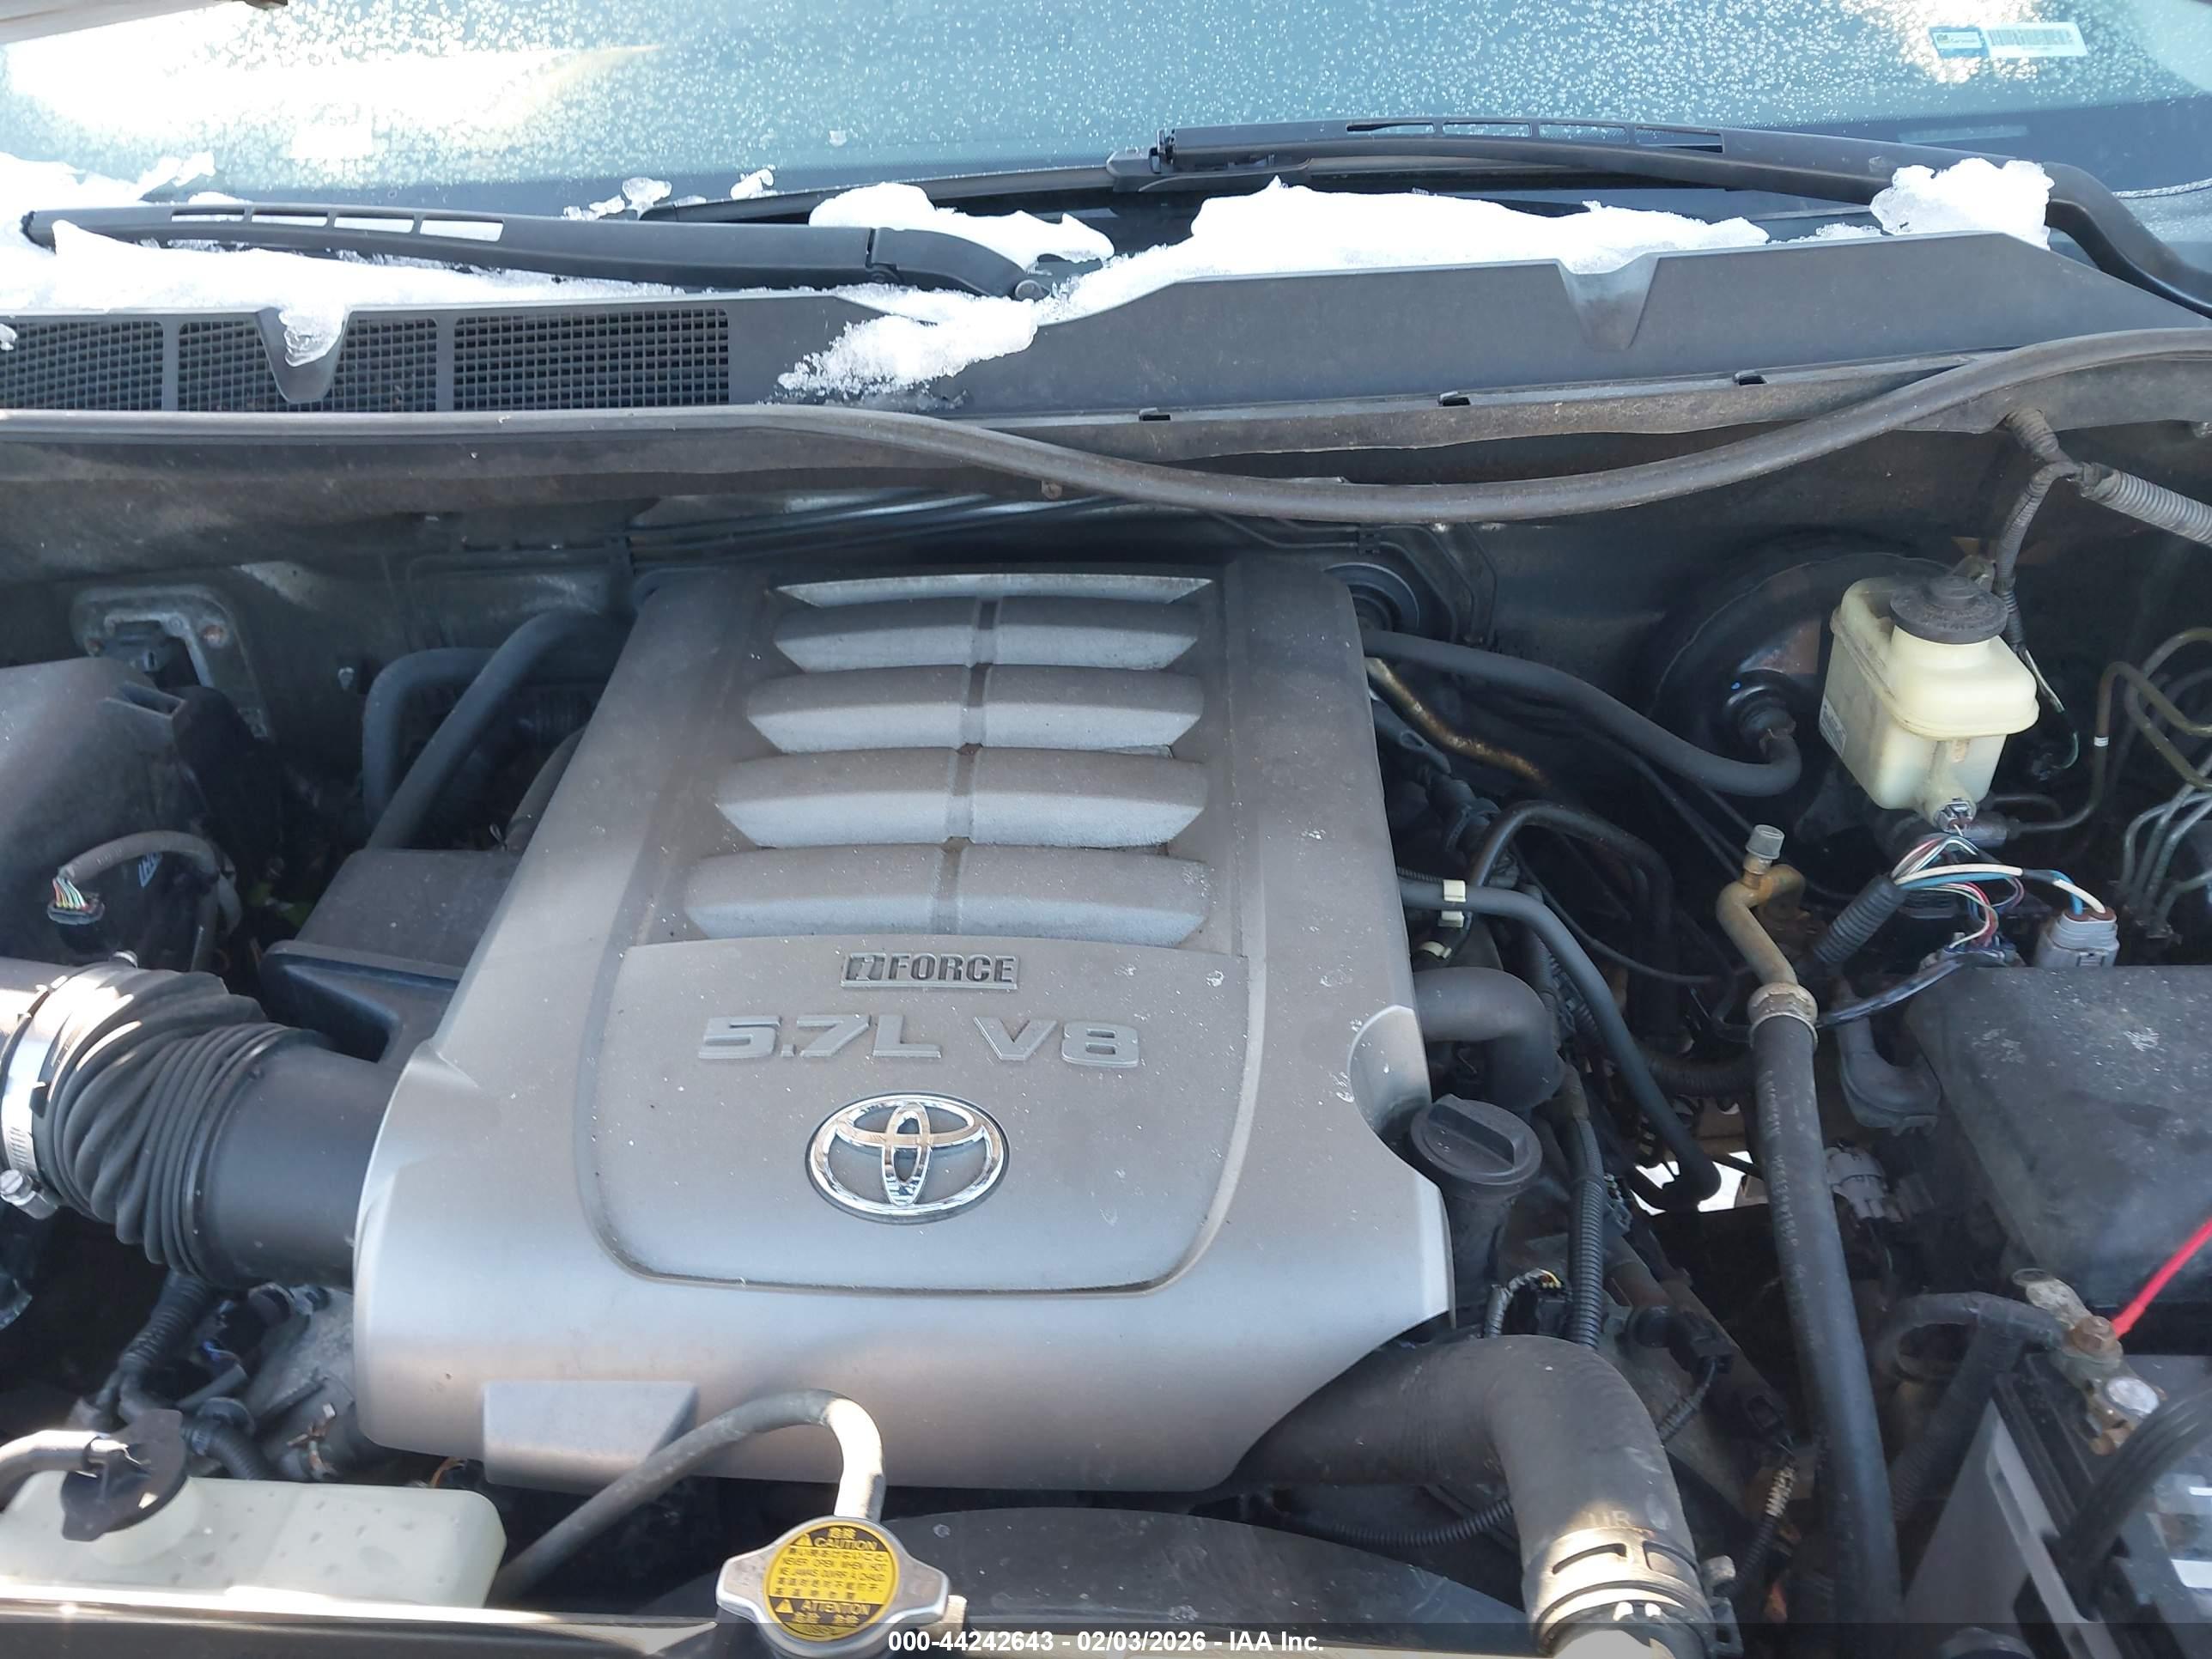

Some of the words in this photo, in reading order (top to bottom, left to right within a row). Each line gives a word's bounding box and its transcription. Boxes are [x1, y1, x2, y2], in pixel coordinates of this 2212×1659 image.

[698, 1013, 941, 1060] 5.7L
[972, 1015, 1140, 1070] V8
[813, 1537, 878, 1551] CAUTION
[800, 1599, 871, 1616] ATTENTION
